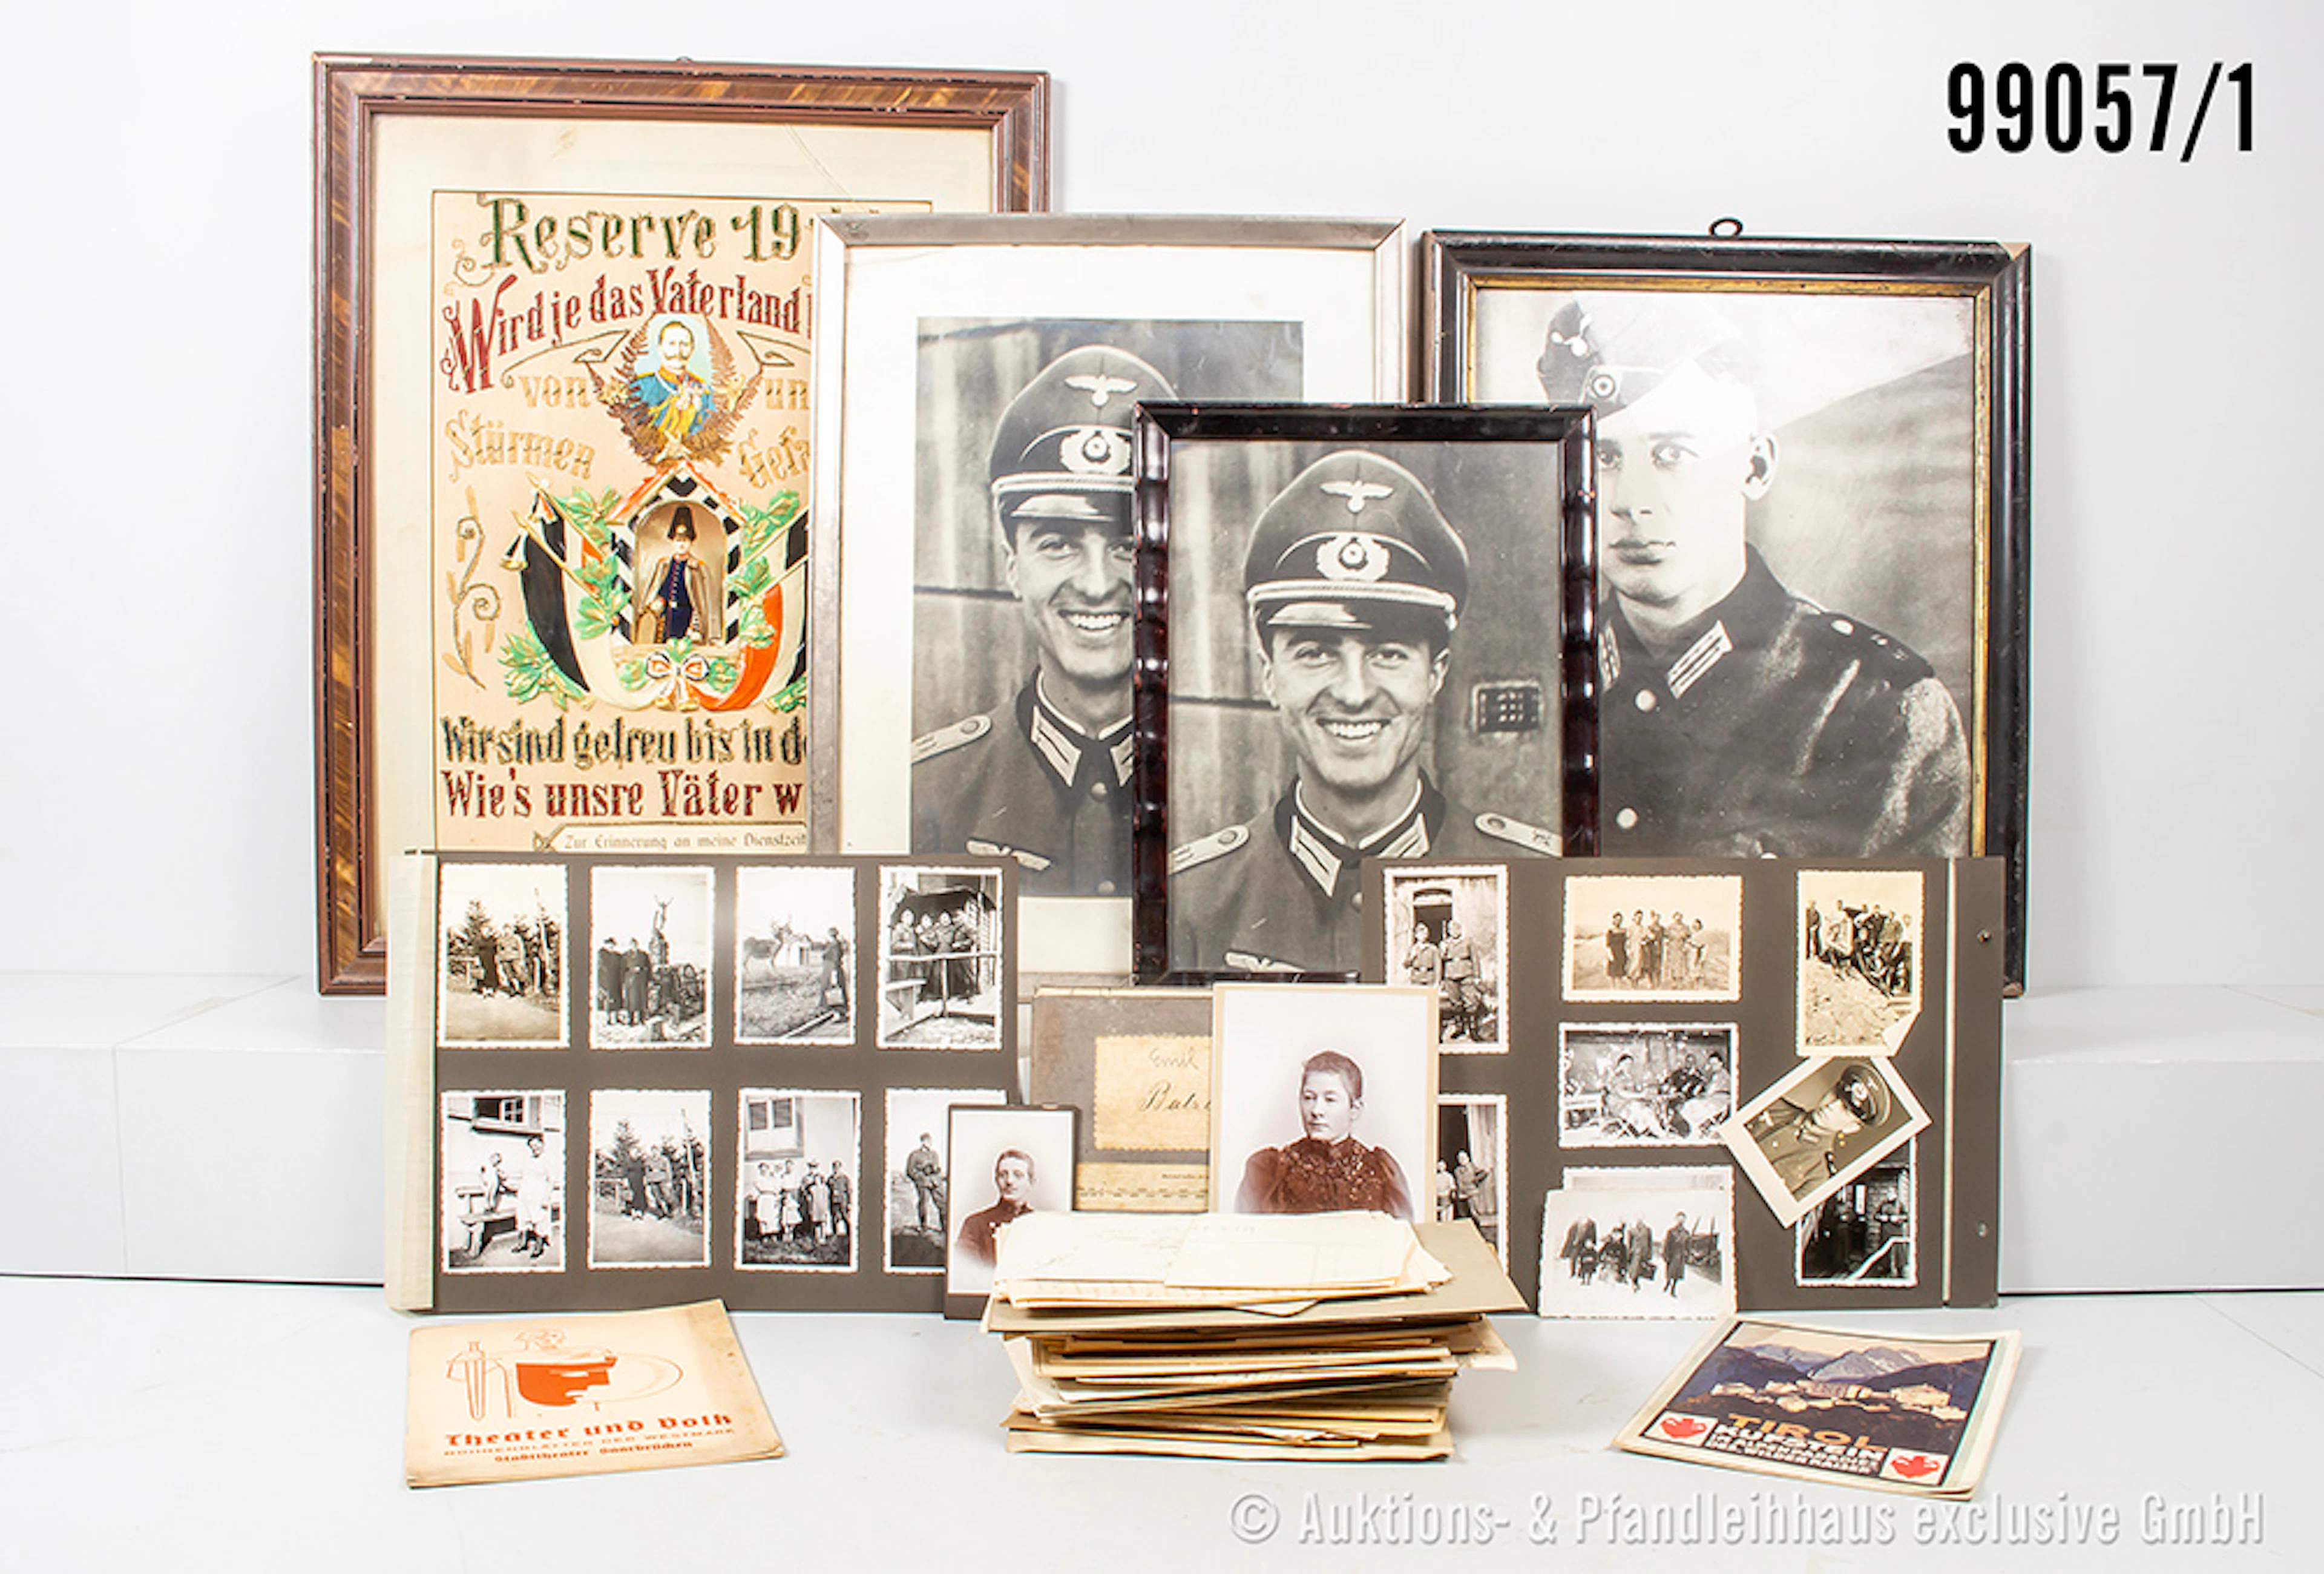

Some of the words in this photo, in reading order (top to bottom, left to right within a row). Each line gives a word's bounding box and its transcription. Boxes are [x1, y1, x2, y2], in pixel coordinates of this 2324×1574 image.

[455, 194, 715, 275] Reserve
[731, 202, 814, 263] 19
[441, 273, 544, 394] Wird
[551, 291, 580, 346] je
[590, 274, 645, 323] das
[646, 266, 802, 334] Vaterland
[517, 374, 592, 409] von
[764, 378, 810, 410] un
[445, 409, 596, 482] Stürmen
[440, 716, 495, 762] Wir
[496, 715, 566, 765] sind
[440, 766, 532, 818] Wie's
[545, 780, 643, 818] unsre
[658, 769, 762, 817] Väter
[594, 834, 667, 850] Erinnerung
[674, 835, 691, 848] an
[697, 834, 737, 848] meine
[445, 1427, 570, 1446] Theater
[583, 1420, 644, 1436] und
[1713, 1423, 1885, 1461] KUFSTEIN
[1728, 1413, 1888, 1452] TIROL
